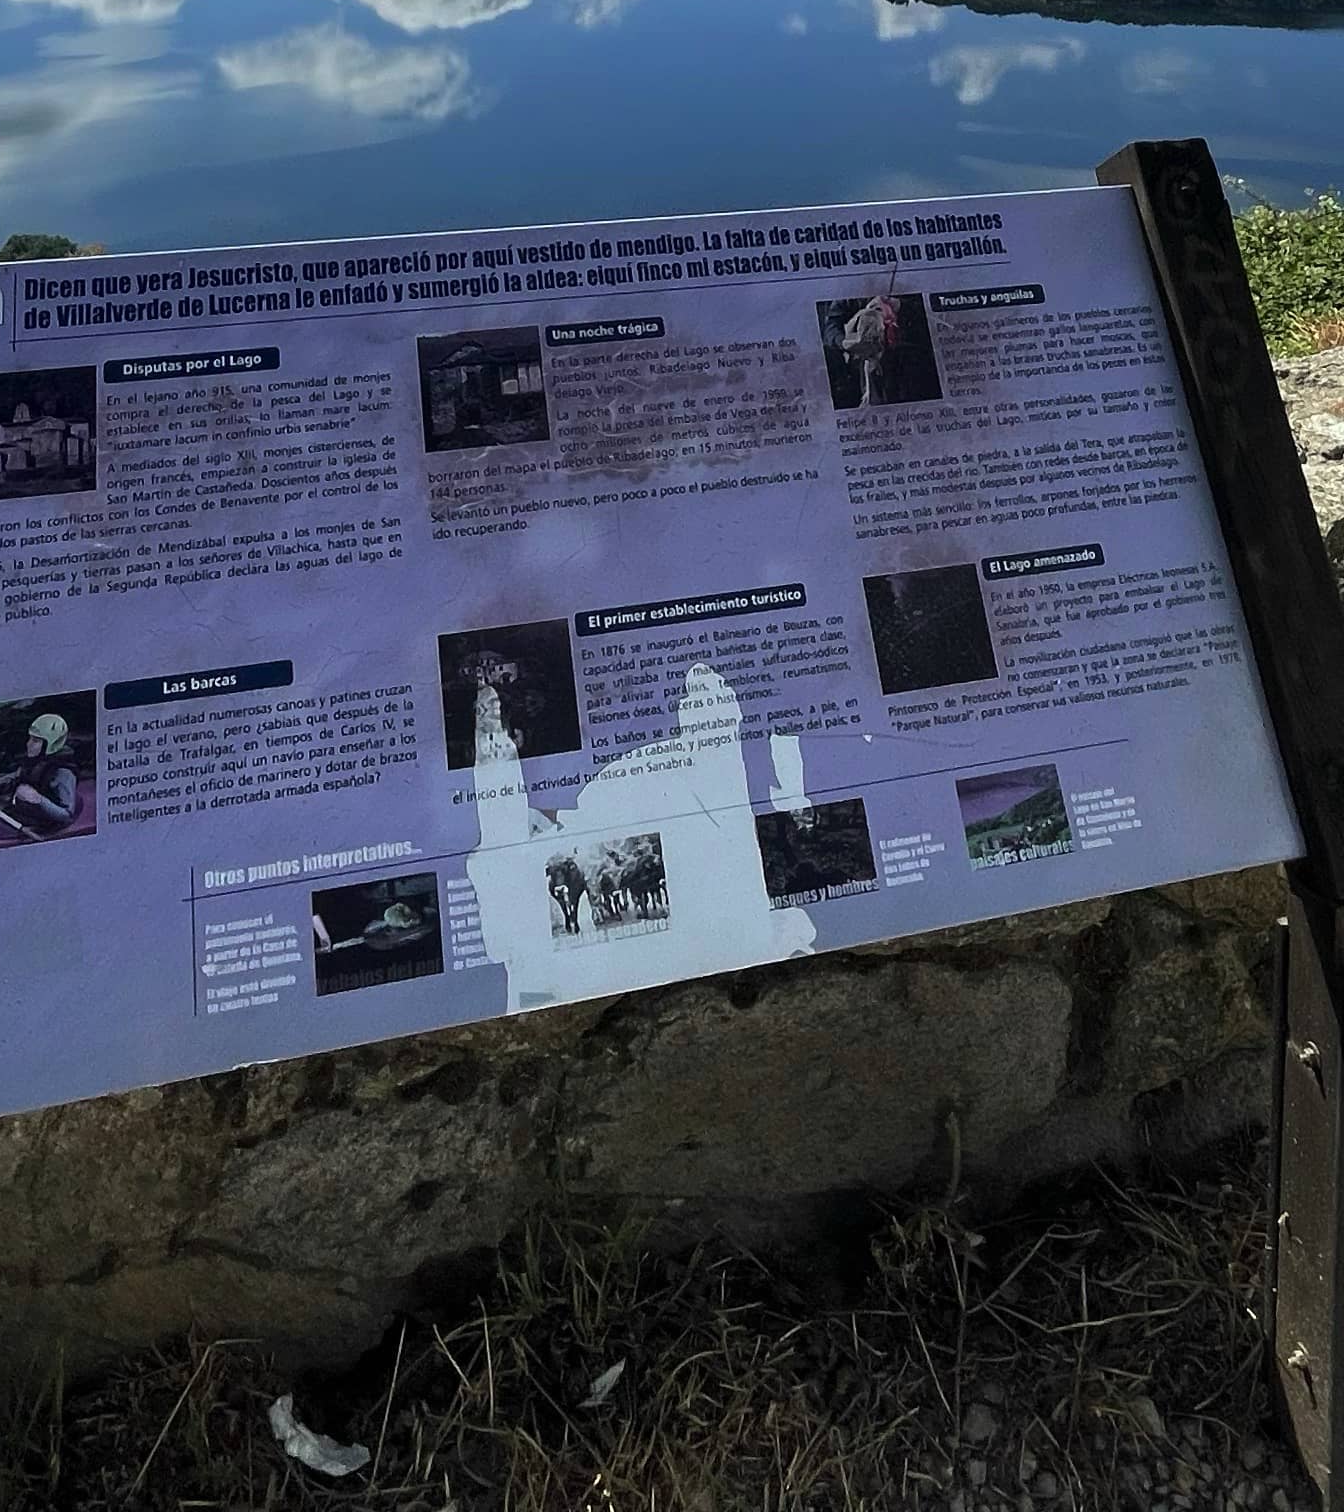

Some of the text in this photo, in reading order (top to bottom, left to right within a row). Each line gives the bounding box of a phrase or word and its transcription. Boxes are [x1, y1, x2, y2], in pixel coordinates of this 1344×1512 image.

[23, 212, 1003, 301] Dicen que yera Jesucristo, que apareció por aquí vestido de mendigo. La falta de caridad de los habitantes
[22, 233, 1008, 330] de Villalverde de Lucerna le enfadó y sumergió la aldea: eiquí finco mi estacón, y eiquí salga un gargallón.
[937, 288, 1035, 306] Truchas y anguilas
[550, 321, 659, 340] Una noche trágica
[122, 353, 262, 377] Disputas por el Lago
[988, 548, 1096, 574] El Lago amenazado
[586, 588, 802, 629] El primer establecimiento turístico
[162, 673, 237, 695] Las barcas
[106, 683, 413, 736] En la actualidad numerosas canoas y patines cruzan
[106, 769, 381, 825] inteligentes a la derrotada armada española?
[969, 840, 1074, 872] paisajes culturales
[203, 867, 246, 889] Otros
[246, 858, 300, 883] puntos
